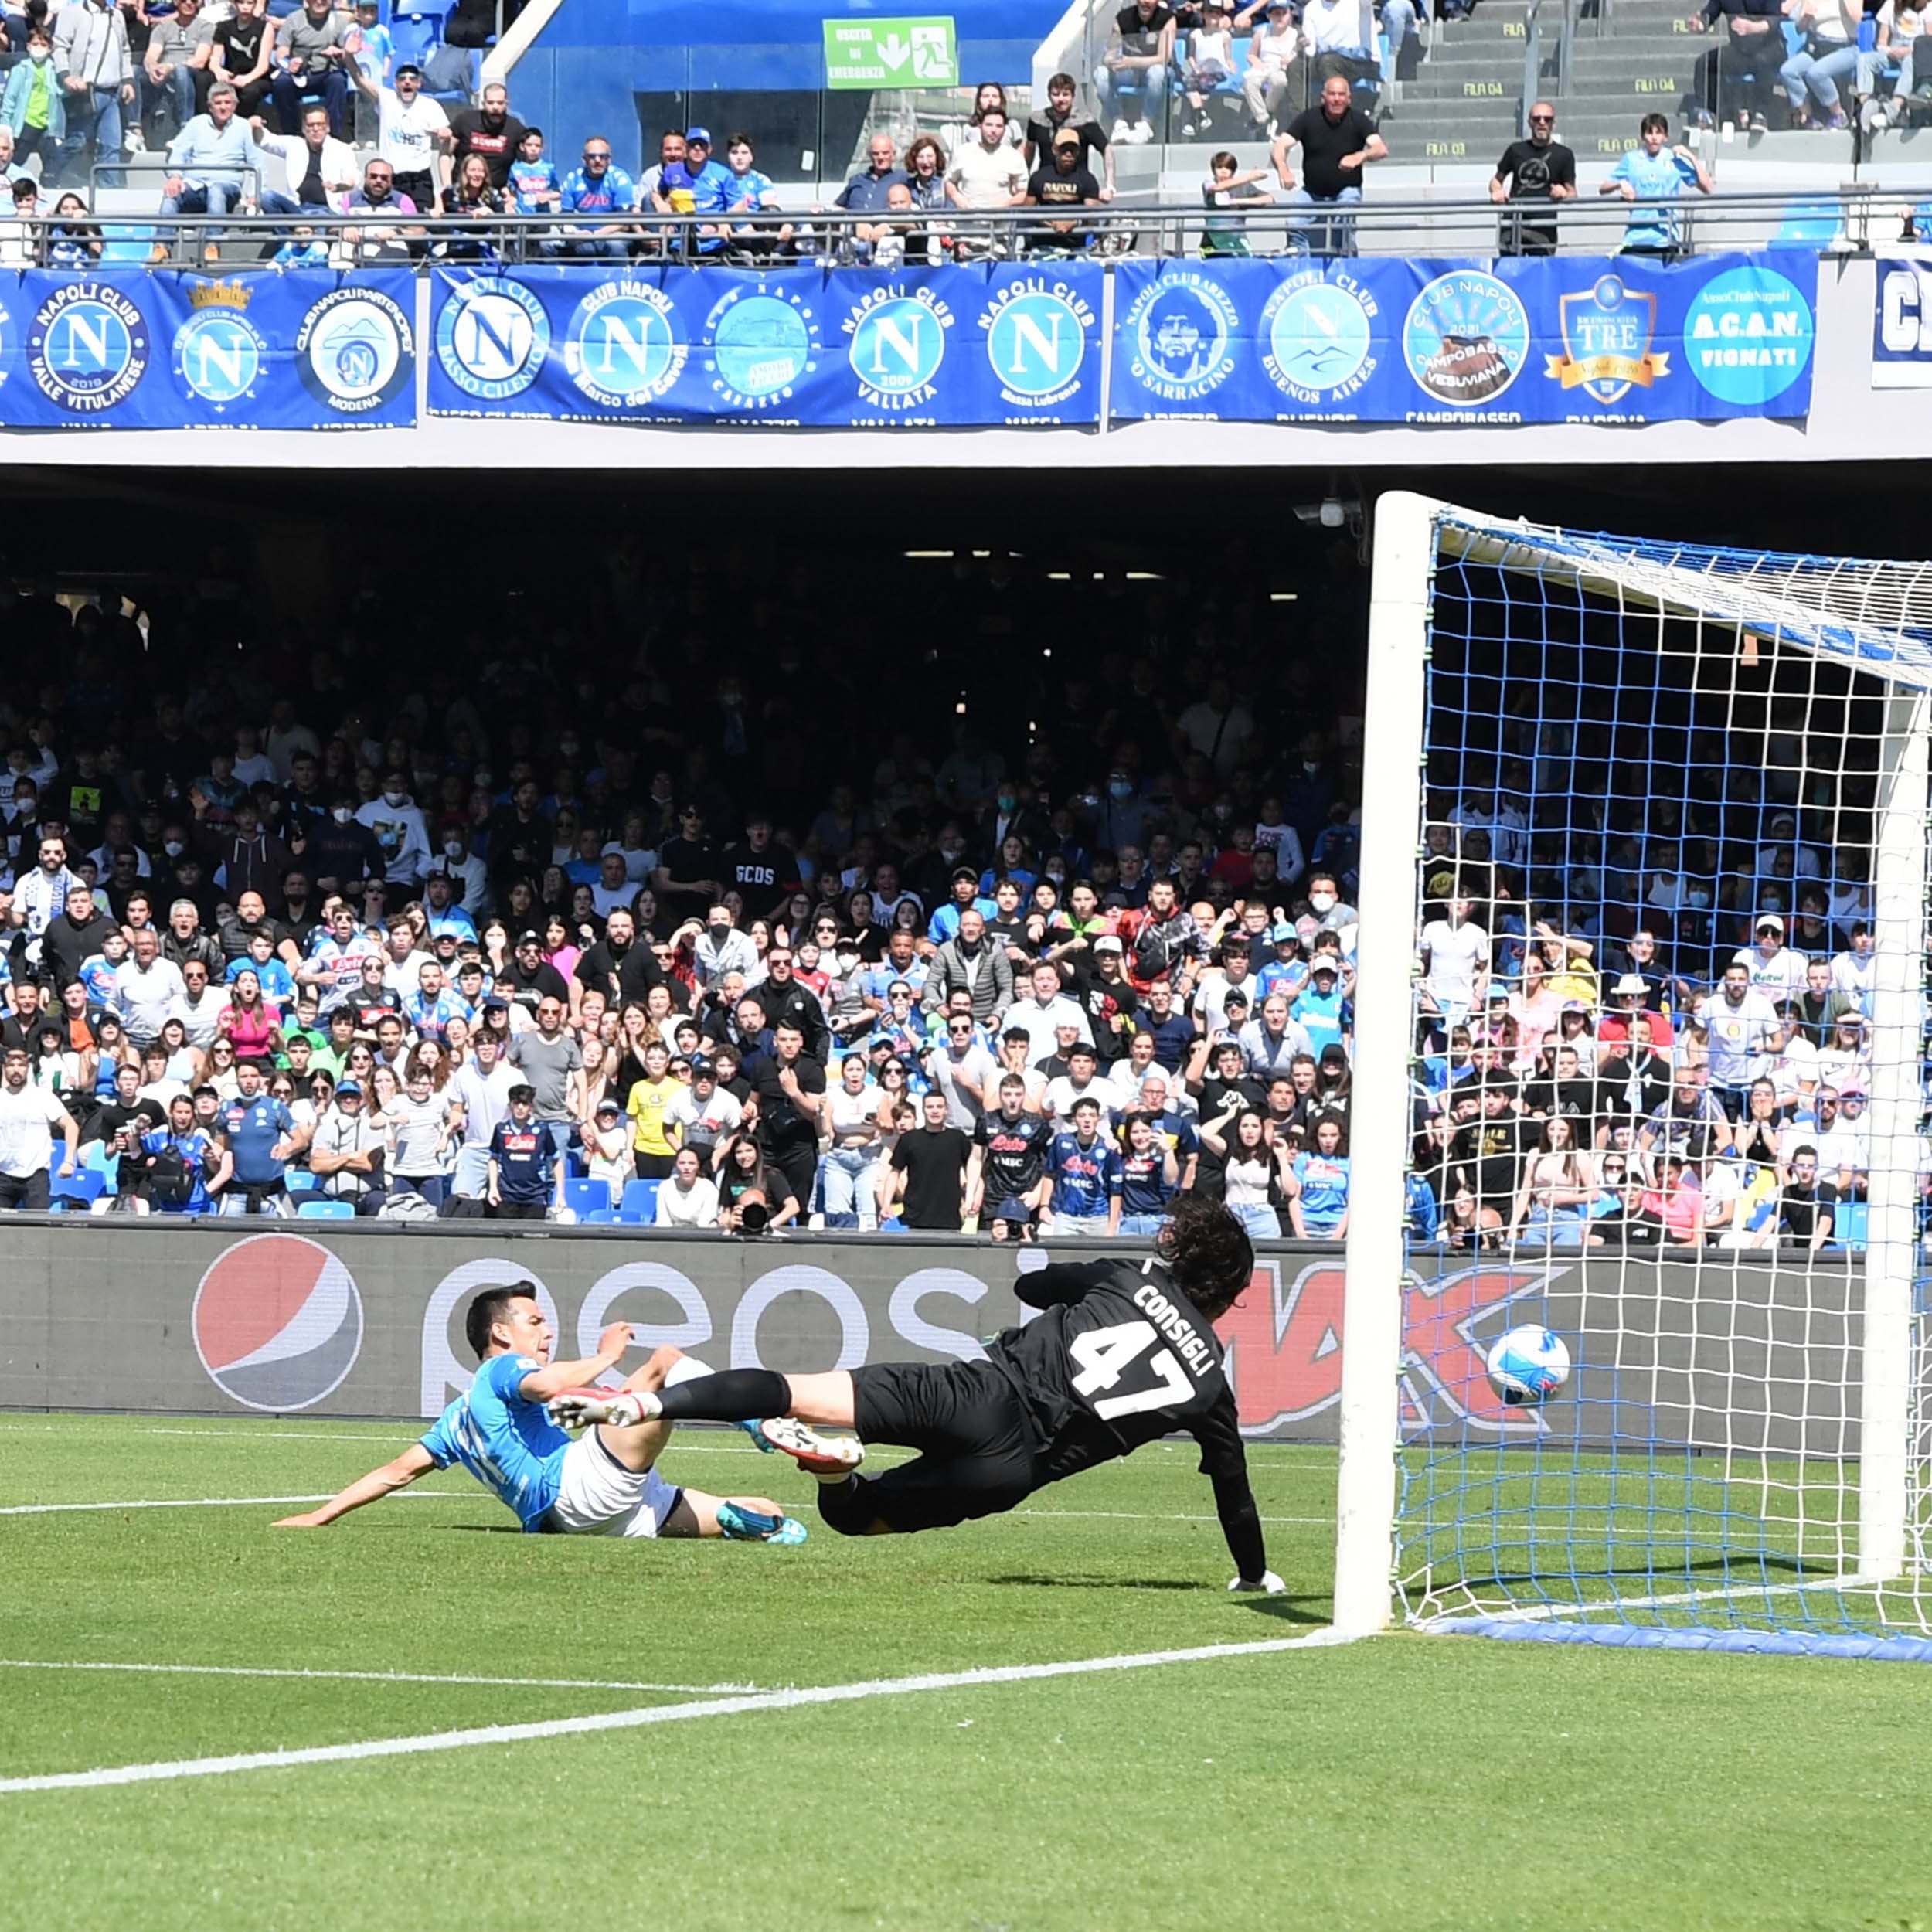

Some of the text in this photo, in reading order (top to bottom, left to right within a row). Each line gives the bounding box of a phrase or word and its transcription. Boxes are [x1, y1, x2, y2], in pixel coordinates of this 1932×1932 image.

[1673, 19, 1689, 32] FIL
[828, 66, 886, 78] EMERGENZA
[1464, 82, 1503, 96] FILA 04
[1634, 77, 1675, 92] FILA 04
[1426, 141, 1465, 155] FILA 03
[1598, 138, 1638, 152] FILA 03
[36, 284, 98, 326] NAPOLI
[100, 287, 141, 326] CLUB
[507, 281, 545, 323] CLUB
[581, 281, 674, 313] CLUB NAPOLI
[841, 284, 955, 334] NAPOLI CLUB
[978, 277, 1096, 330] NAPOLI CLUB
[1126, 281, 1162, 326] NAPOLI
[1162, 272, 1201, 286] CLUB
[1264, 270, 1379, 319] NAPOLI CLUB
[1413, 281, 1522, 328] CLUB NAPOLI
[62, 314, 111, 367] N
[297, 312, 318, 352] CLUB
[315, 288, 356, 315] NAPOLI
[467, 308, 522, 367] N
[1577, 323, 1638, 352] TRE
[1692, 311, 1803, 338] A.C.A.N.
[195, 334, 246, 387] N
[596, 315, 654, 376] N
[869, 314, 924, 373] N
[1008, 312, 1064, 373] N
[1416, 342, 1519, 369] CAMPOBASSO
[31, 356, 145, 410] VALLE VITULANESE
[482, 349, 546, 400] CILENTO
[858, 383, 938, 410] VALLATA
[1142, 358, 1235, 400] SARRACINO
[1262, 355, 1378, 404] BUENOS AIRES
[1427, 361, 1506, 388] VESUVIANA
[328, 395, 382, 411] MODENA
[736, 865, 775, 885] GCDS
[1134, 1284, 1215, 1377] CONSIGLI
[1070, 1320, 1196, 1422] 47
